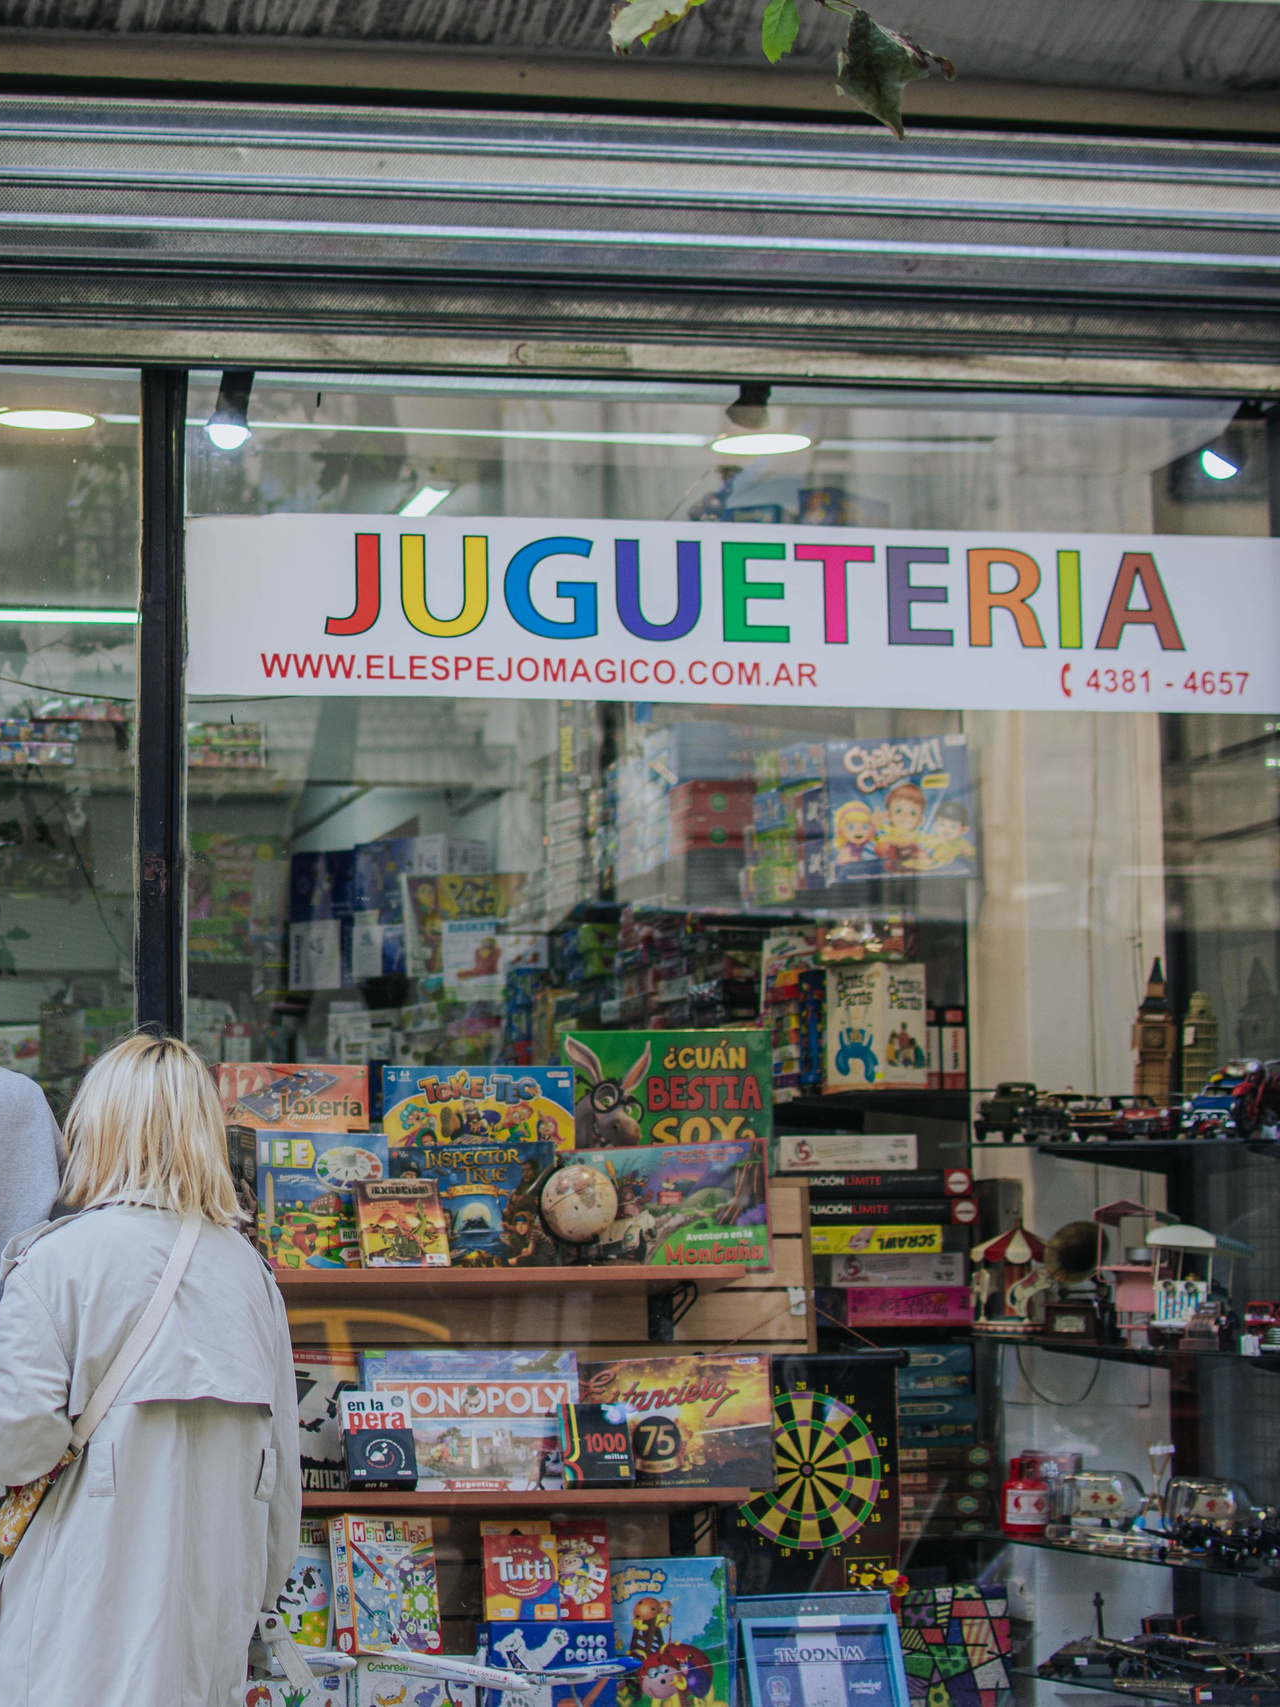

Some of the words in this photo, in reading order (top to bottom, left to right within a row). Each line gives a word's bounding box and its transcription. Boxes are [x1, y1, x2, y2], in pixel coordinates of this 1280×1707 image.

[324, 532, 1186, 652] JUGUETERIA
[261, 652, 818, 687] WWW.ELESPEJOMAGICO.COM.AR
[1086, 669, 1151, 694] 4381
[1184, 671, 1250, 696] 4657
[663, 1039, 747, 1070] ¿CUÁN
[647, 1075, 763, 1111] BESTIA
[280, 1094, 363, 1117] Lotería
[260, 1141, 309, 1166] IFE
[423, 1149, 523, 1169] INSPECTOR
[797, 1141, 812, 1161] 5
[460, 1166, 507, 1185] TRUE
[845, 1174, 882, 1186] LÍMITE
[810, 1203, 853, 1215] TUACIÓN
[853, 1203, 889, 1215] LÍMITE
[686, 1232, 729, 1242] Aventura
[730, 1231, 742, 1239] en
[743, 1230, 753, 1239] la
[877, 1233, 937, 1250] SCRAWL
[664, 1240, 765, 1265] Montaña
[795, 1382, 807, 1391] 20
[824, 1385, 829, 1393] 1
[347, 1400, 366, 1411] en
[370, 1399, 384, 1411] la
[384, 1386, 564, 1415] ONOPOLY
[348, 1411, 406, 1435] pera
[584, 1433, 627, 1453] 1000
[639, 1425, 676, 1456] 75
[877, 1438, 888, 1446] 13
[455, 1480, 500, 1489] Argentina
[871, 1513, 881, 1522] 15
[352, 1521, 427, 1543] Mandalas
[808, 1551, 814, 1560] 3
[832, 1547, 841, 1556] 17
[491, 1556, 552, 1583] Tutti
[576, 1635, 608, 1649] OSO
[565, 1648, 608, 1662] POLO
[774, 1645, 865, 1663] WINGOAL
[367, 1662, 412, 1673] Colorea
[478, 1669, 502, 1680] CANADA
